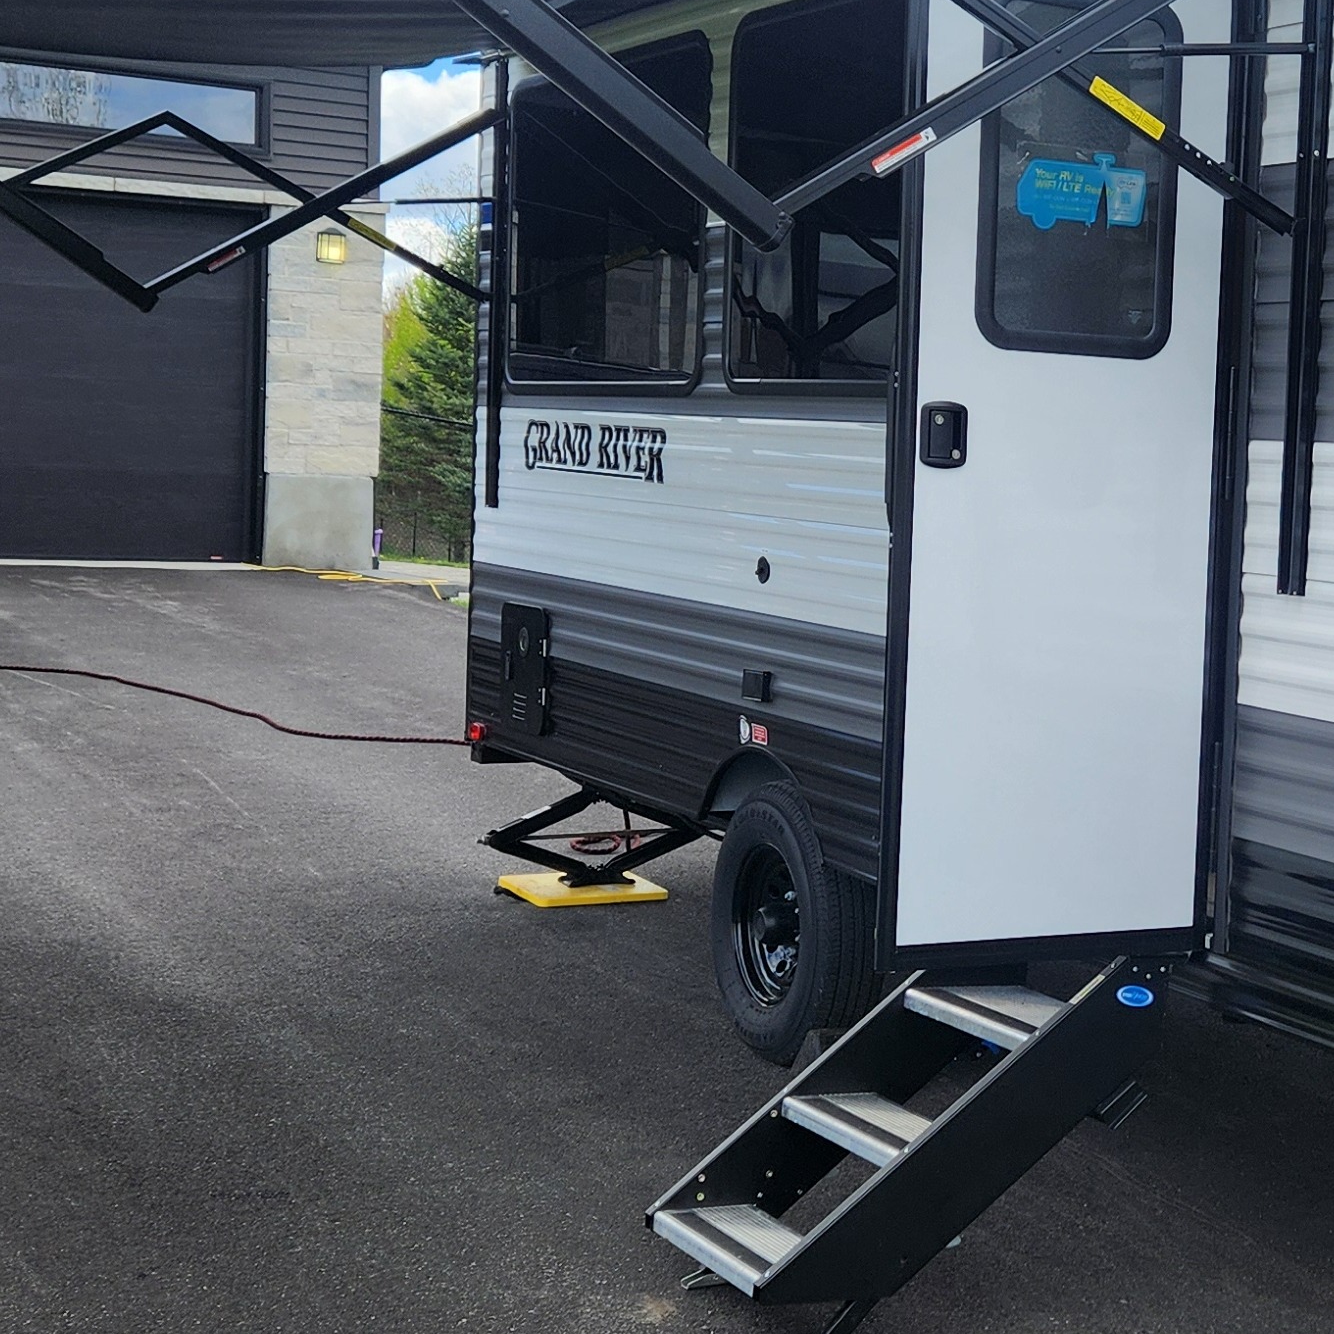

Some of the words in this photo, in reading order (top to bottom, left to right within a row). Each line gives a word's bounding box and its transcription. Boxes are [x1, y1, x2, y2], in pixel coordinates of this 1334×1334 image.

[1035, 168, 1058, 179] Your
[1059, 170, 1074, 182] RV
[1062, 181, 1082, 193] LTE
[524, 419, 592, 470] GRAND
[597, 424, 667, 484] RIVER
